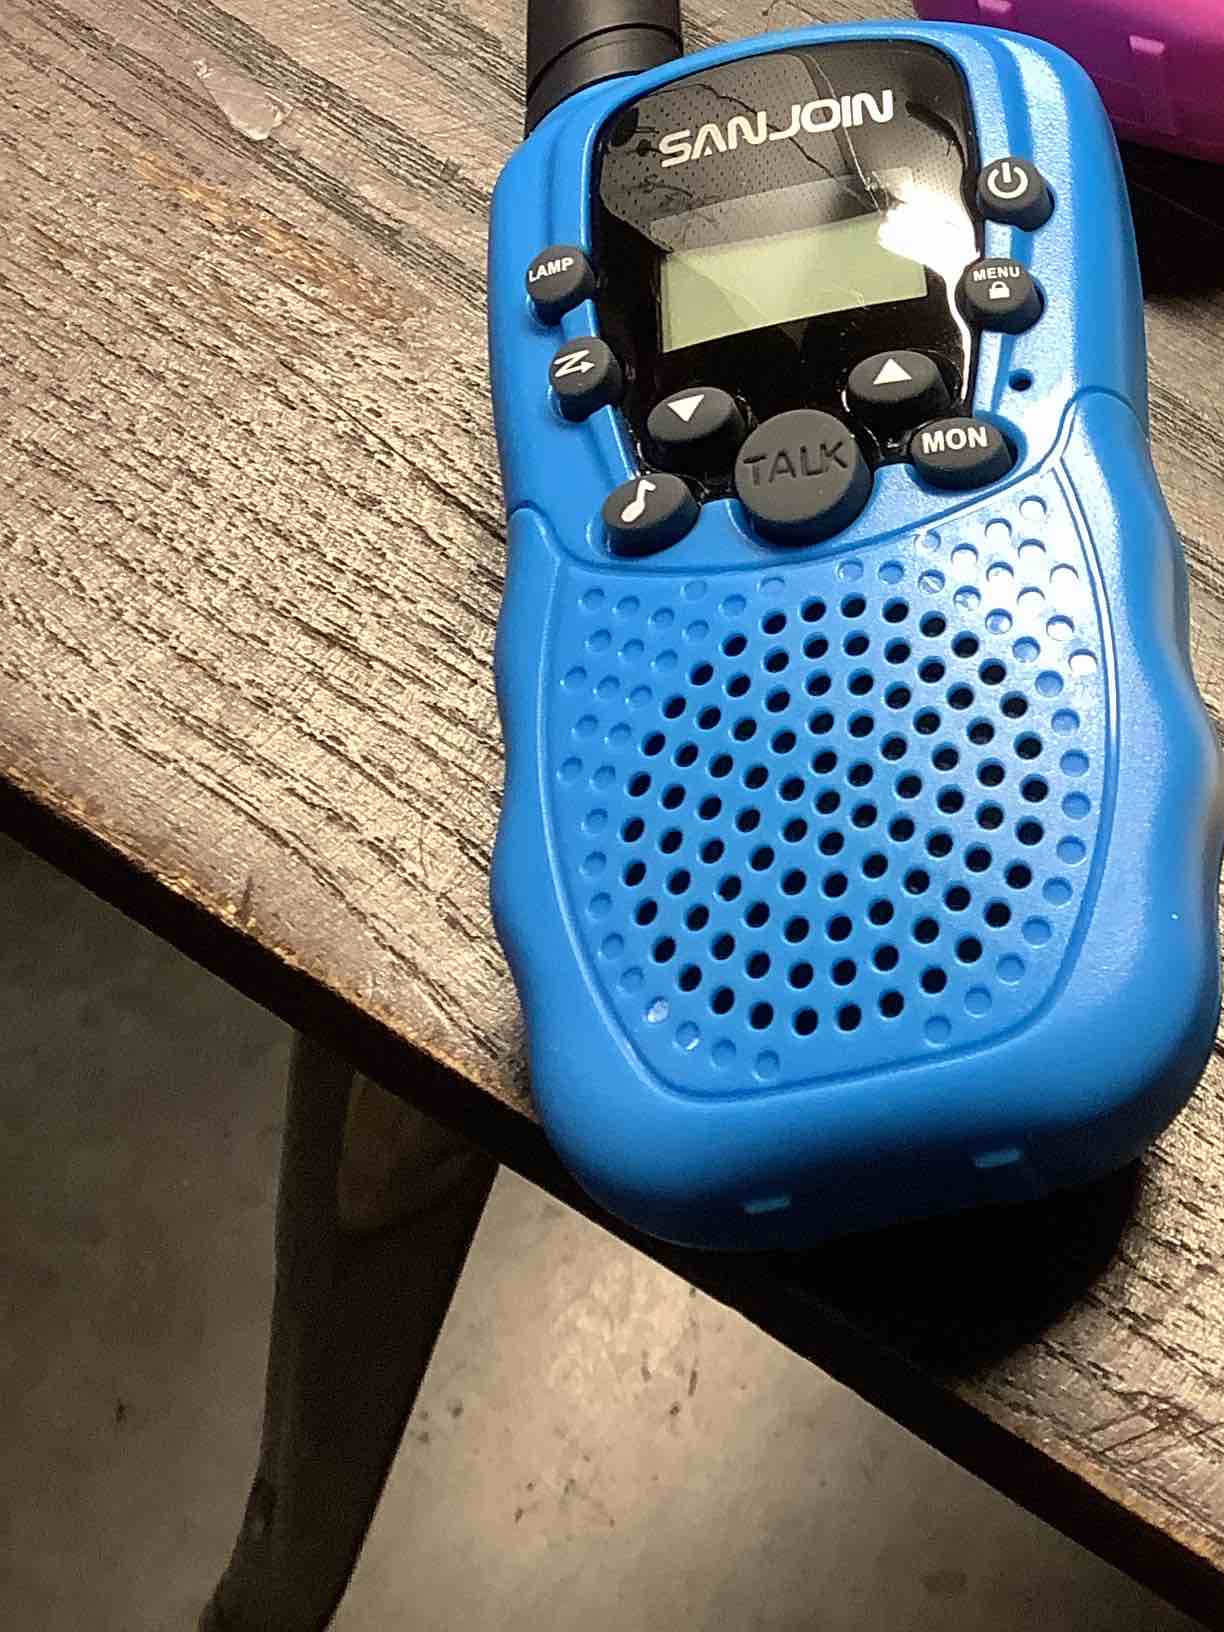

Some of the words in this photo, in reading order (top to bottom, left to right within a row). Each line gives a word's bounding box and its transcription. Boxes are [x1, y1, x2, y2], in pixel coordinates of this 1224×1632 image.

[658, 88, 895, 169] SANJOIN
[527, 257, 575, 282] LAMP
[972, 265, 1021, 281] MENU
[921, 426, 989, 455] MON
[742, 441, 850, 487] TALK
